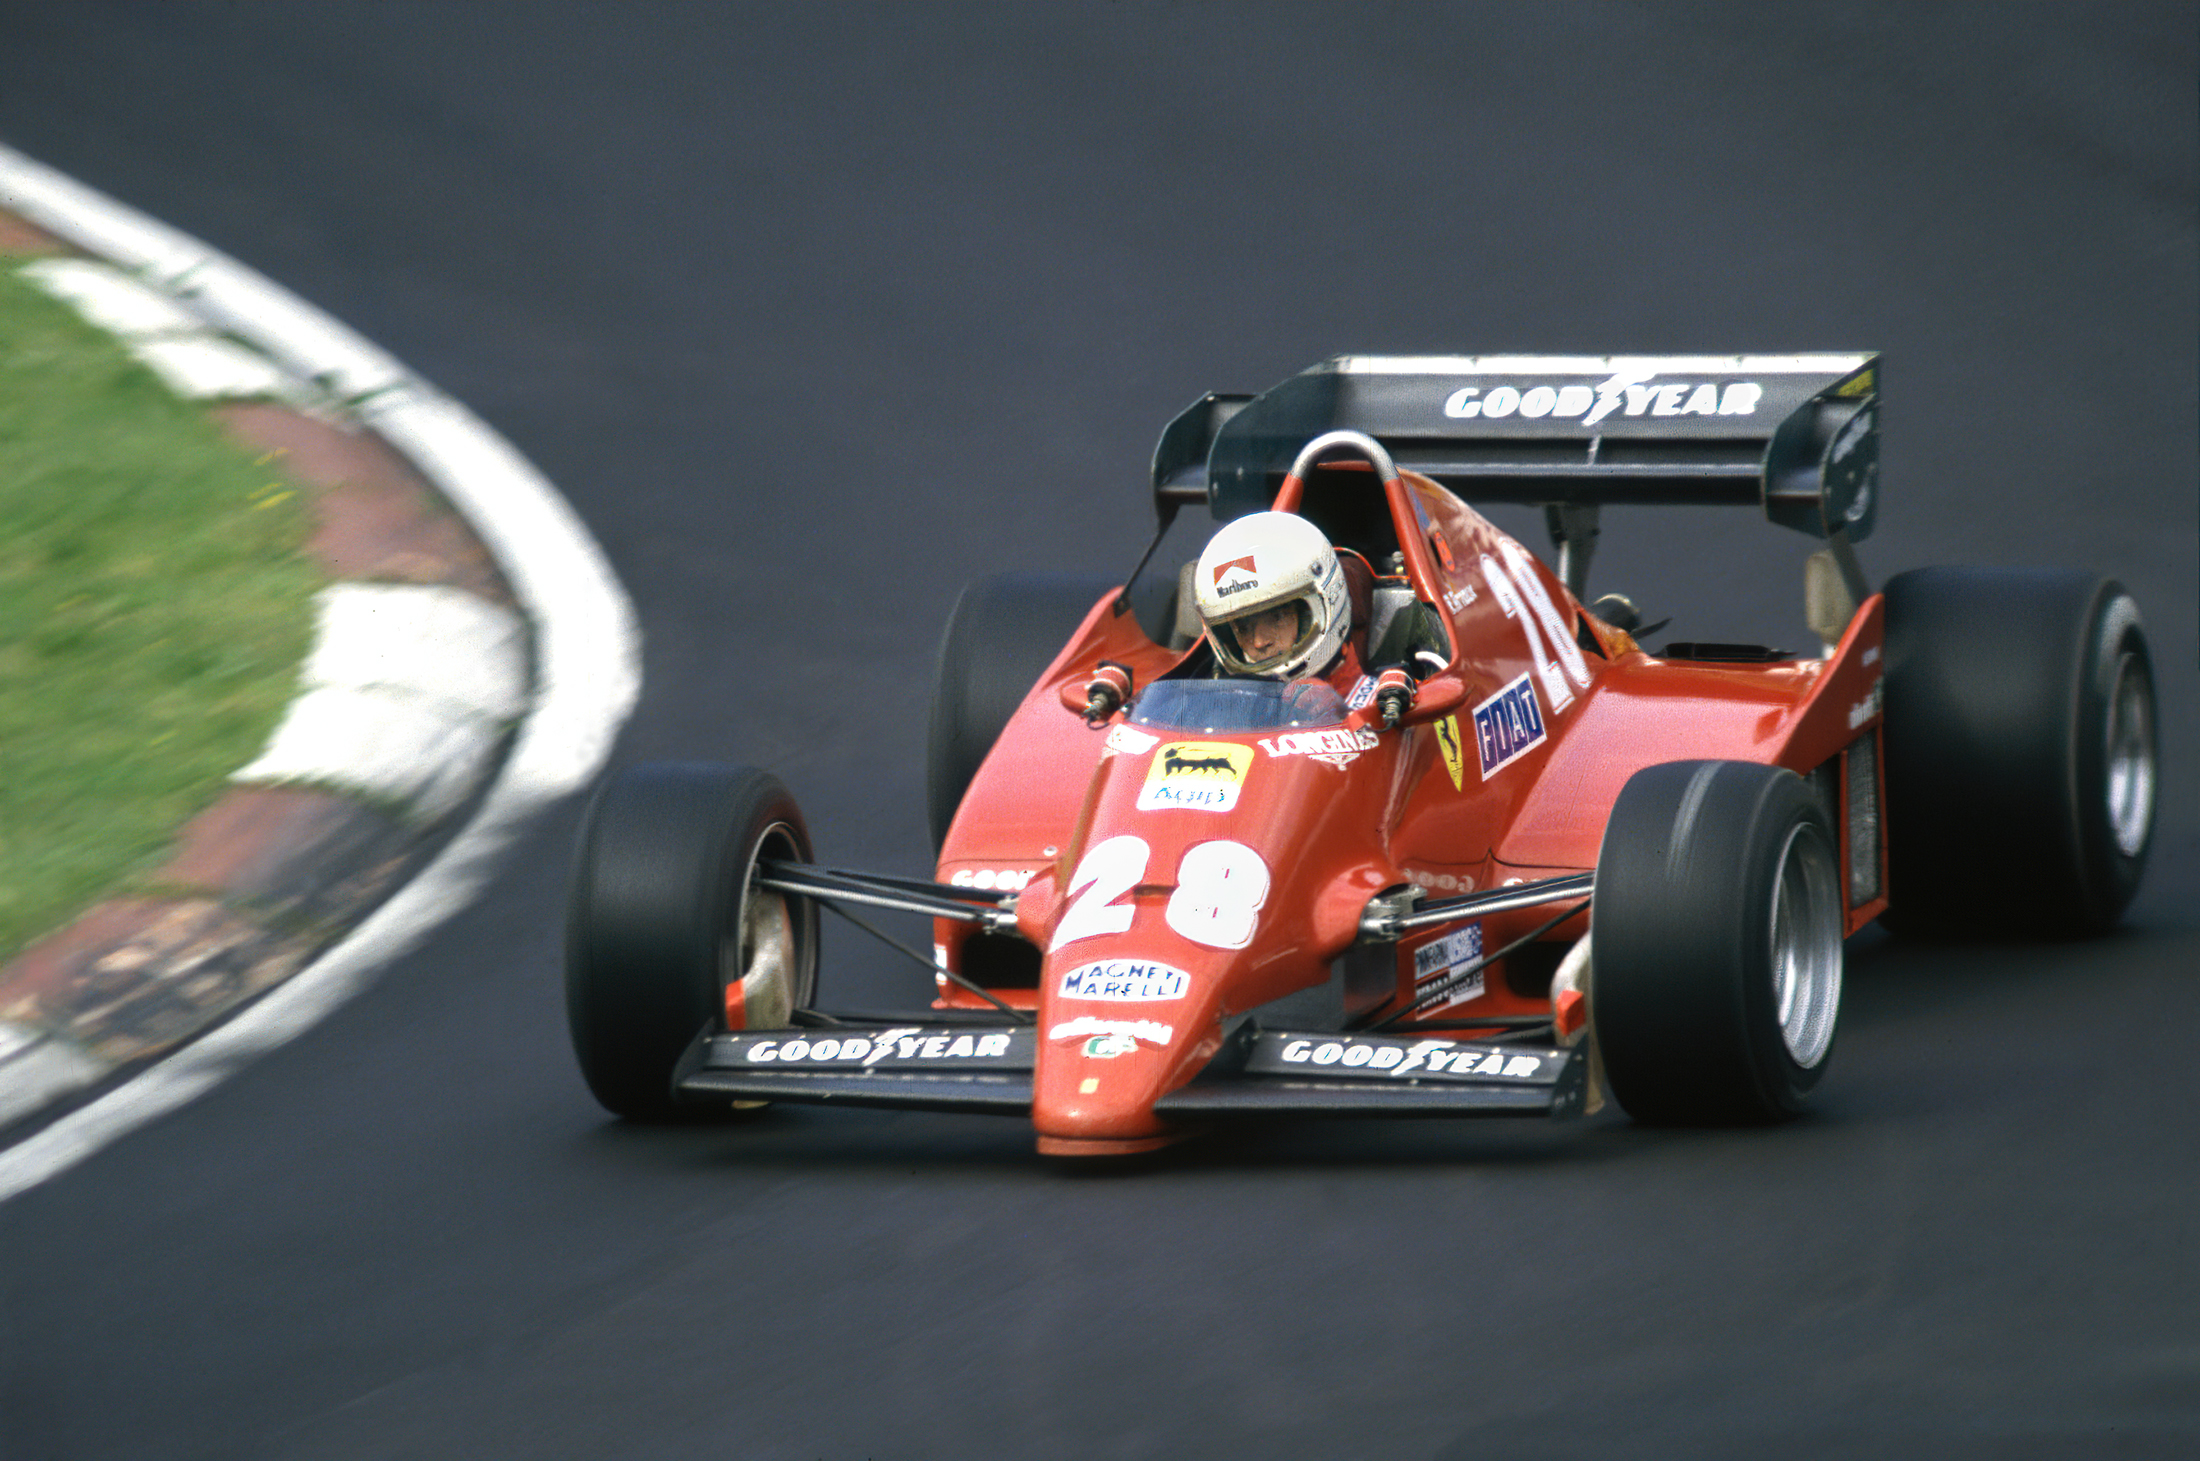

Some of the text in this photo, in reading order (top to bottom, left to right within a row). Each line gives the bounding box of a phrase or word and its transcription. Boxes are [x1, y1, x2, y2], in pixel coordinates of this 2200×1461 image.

[1216, 579, 1259, 599] Marlboro
[1480, 690, 1540, 762] FIAT
[1047, 835, 1271, 955] 28
